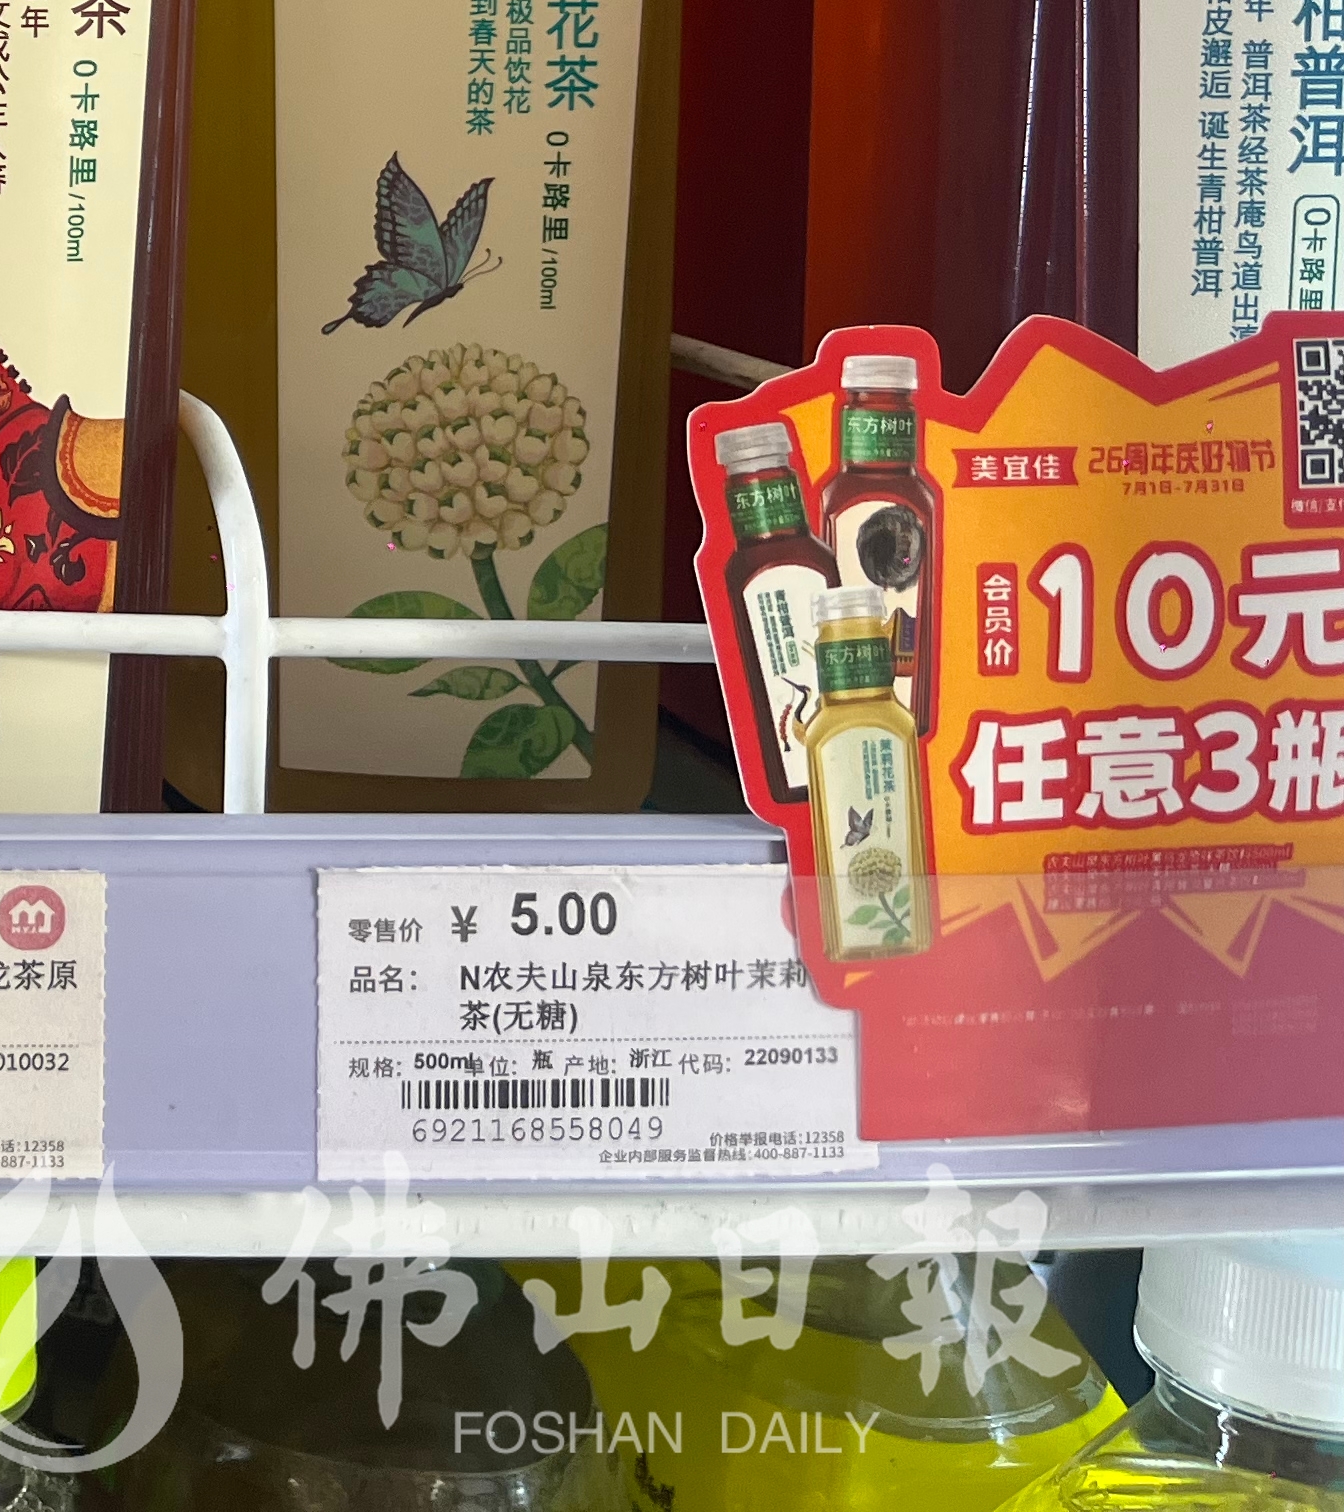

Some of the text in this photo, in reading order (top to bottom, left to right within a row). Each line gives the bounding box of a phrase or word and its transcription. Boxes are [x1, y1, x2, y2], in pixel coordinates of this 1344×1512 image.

[1191, 111, 1229, 298] 诞生青柑普洱
[971, 453, 1061, 482] 美宜佳
[983, 573, 1013, 667] 会员价
[1038, 548, 1344, 672] 10元
[960, 709, 1344, 825] 任意3瓶
[348, 918, 423, 943] 零售价
[510, 892, 618, 937] 5.00
[459, 1000, 578, 1034] 茶(无糖)
[532, 1046, 839, 1071] 瓶 浙江 22090133
[412, 1117, 664, 1143] 6921168558049
